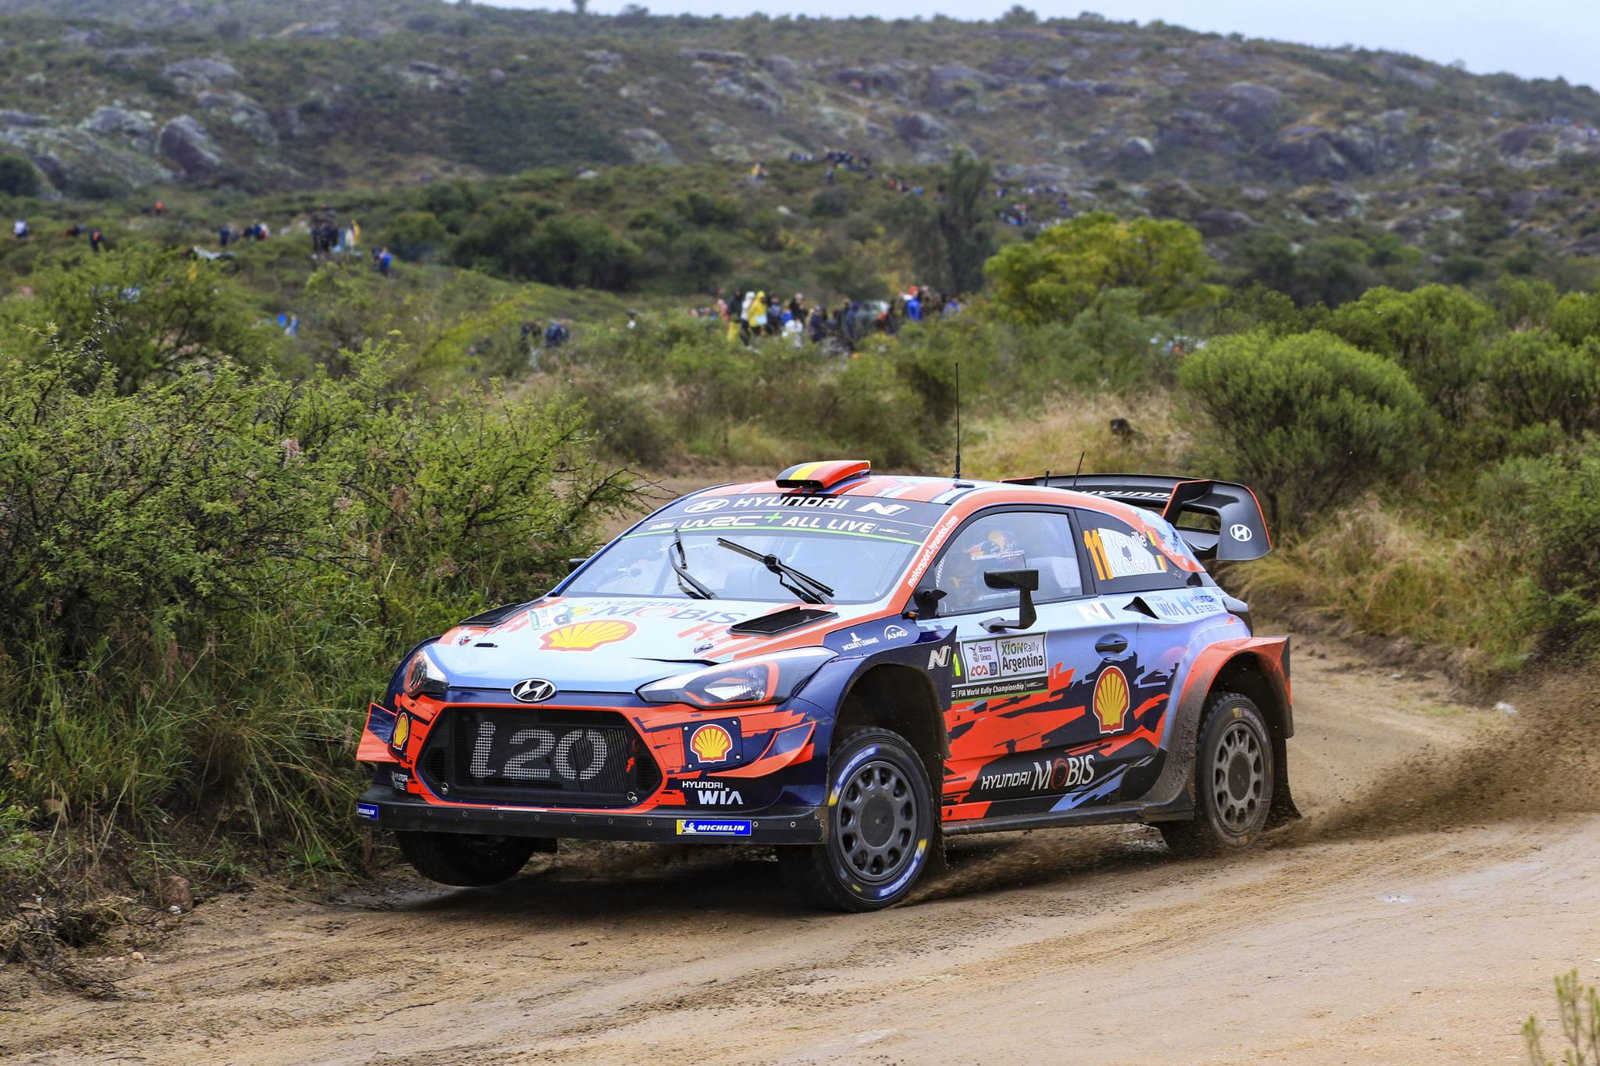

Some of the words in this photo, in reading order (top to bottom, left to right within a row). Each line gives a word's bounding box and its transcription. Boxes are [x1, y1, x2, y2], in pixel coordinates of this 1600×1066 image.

[733, 496, 850, 509] HYUNDAI
[782, 516, 821, 528] ALL
[826, 519, 876, 534] LIVE
[908, 515, 958, 588] motorsport.hyundai.com
[1083, 529, 1113, 580] 11
[590, 606, 748, 624] MOBIS
[1001, 642, 1024, 656] XION
[1023, 641, 1039, 653] Rally
[1002, 654, 1043, 673] Argentina
[966, 687, 980, 697] World
[980, 686, 992, 696] Rally
[992, 682, 1024, 694] Championship
[981, 771, 1031, 790] HYUNDAI
[1031, 754, 1095, 791] MOBIS
[682, 781, 723, 789] HYUNDAI
[697, 788, 744, 805] WIA
